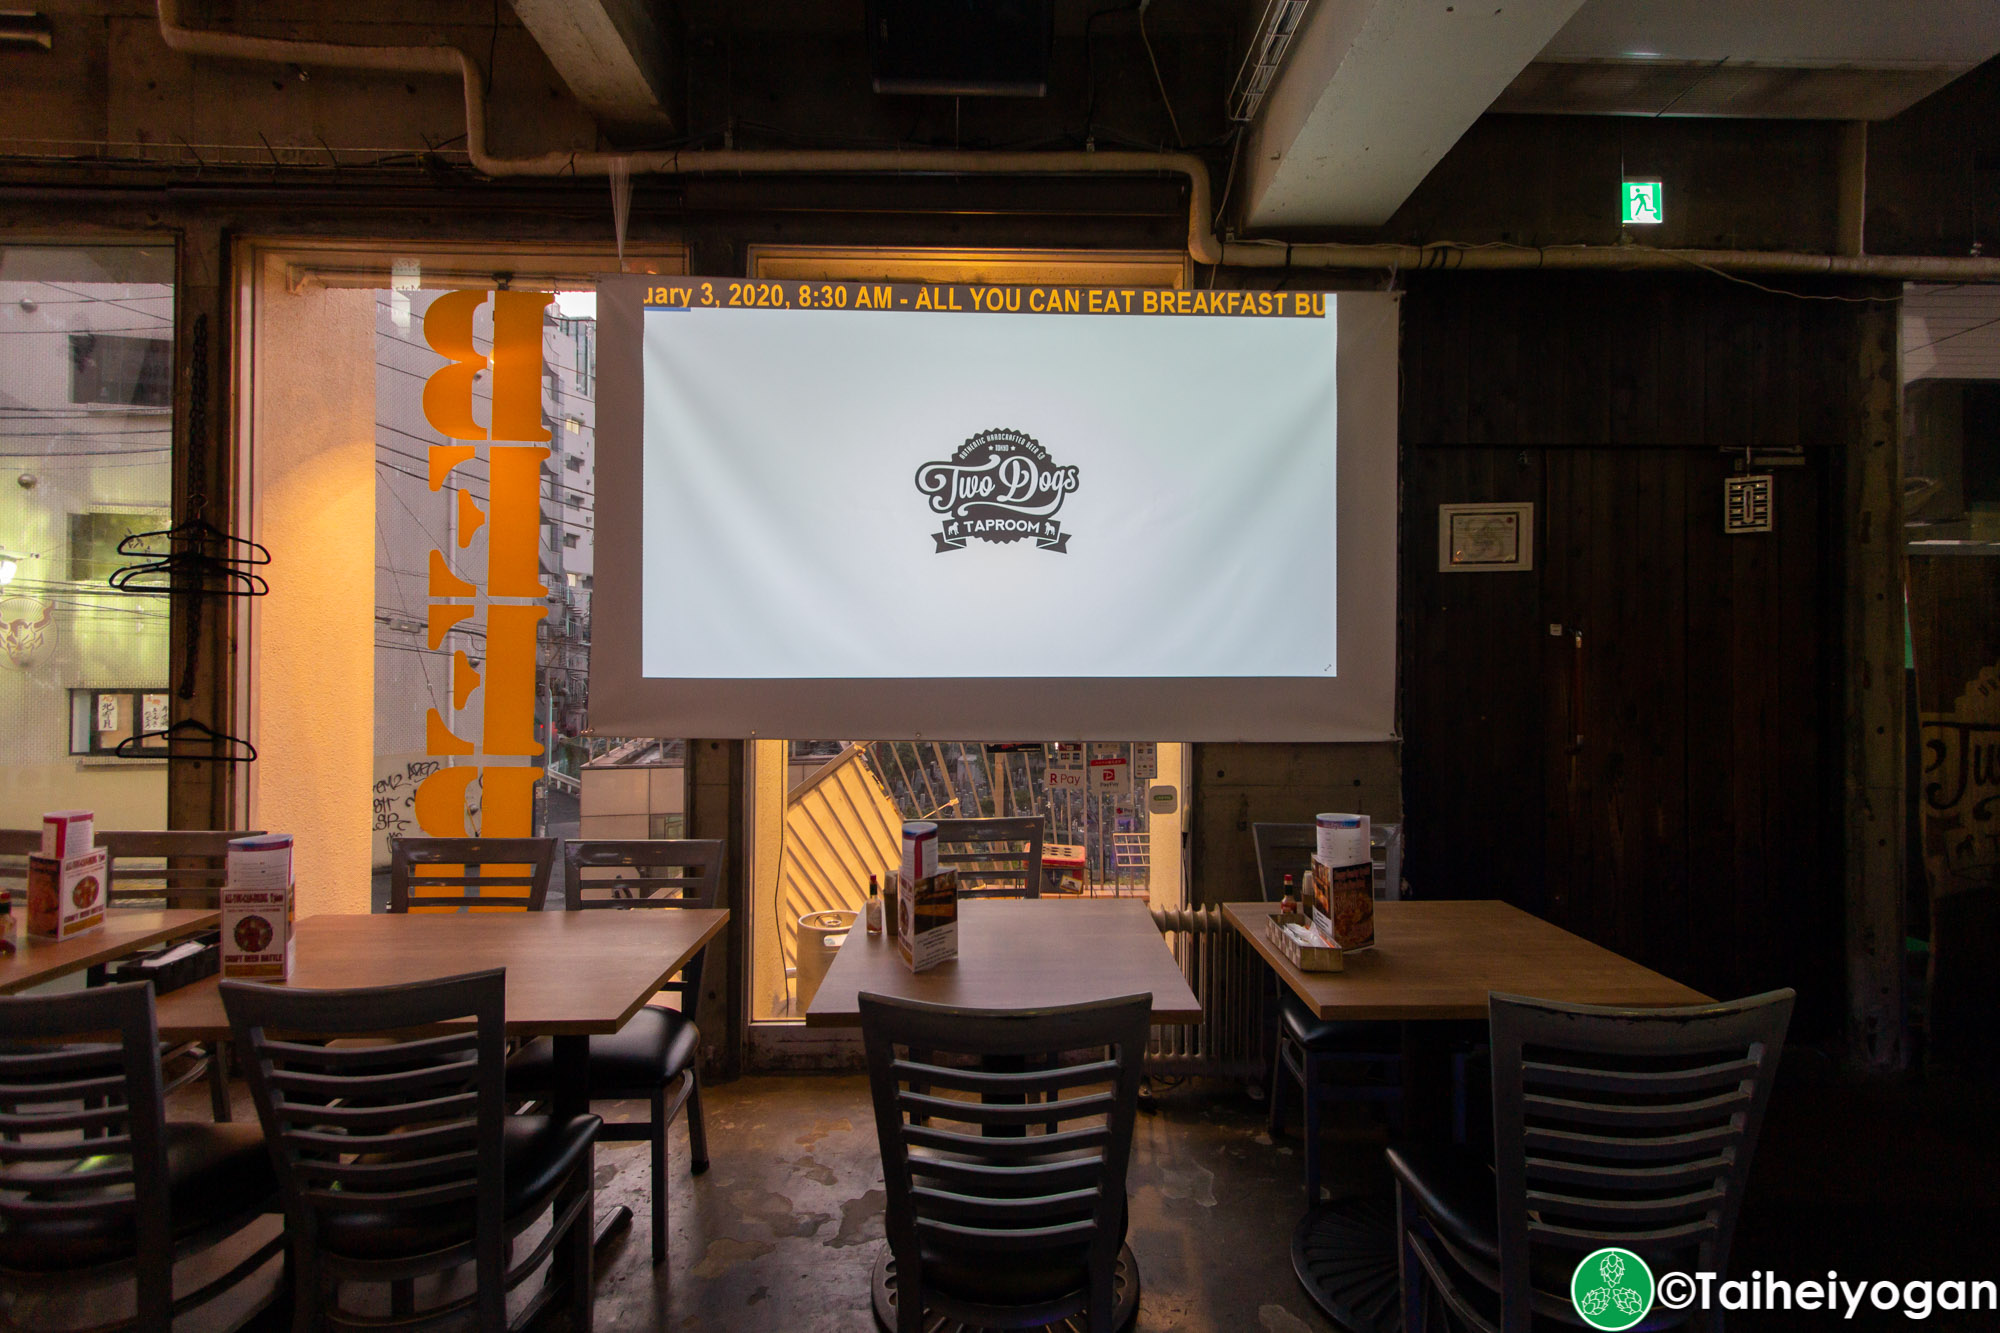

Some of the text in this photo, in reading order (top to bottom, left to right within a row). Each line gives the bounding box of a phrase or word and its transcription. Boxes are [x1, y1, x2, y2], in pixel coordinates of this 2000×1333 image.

[701, 283, 720, 308] 3,
[729, 284, 790, 310] 2020,
[799, 285, 847, 308] 8:30
[855, 286, 892, 309] AM
[915, 287, 962, 311] ALL
[970, 288, 1021, 311] YOU
[1029, 289, 1079, 312] CAN
[1089, 290, 1135, 313] EAT
[1143, 291, 1287, 315] BREAKFAST
[1295, 293, 1326, 316] BU
[918, 454, 1076, 516] Two Dogs
[963, 519, 1040, 533] TAPROOM
[1060, 773, 1081, 786] Pay
